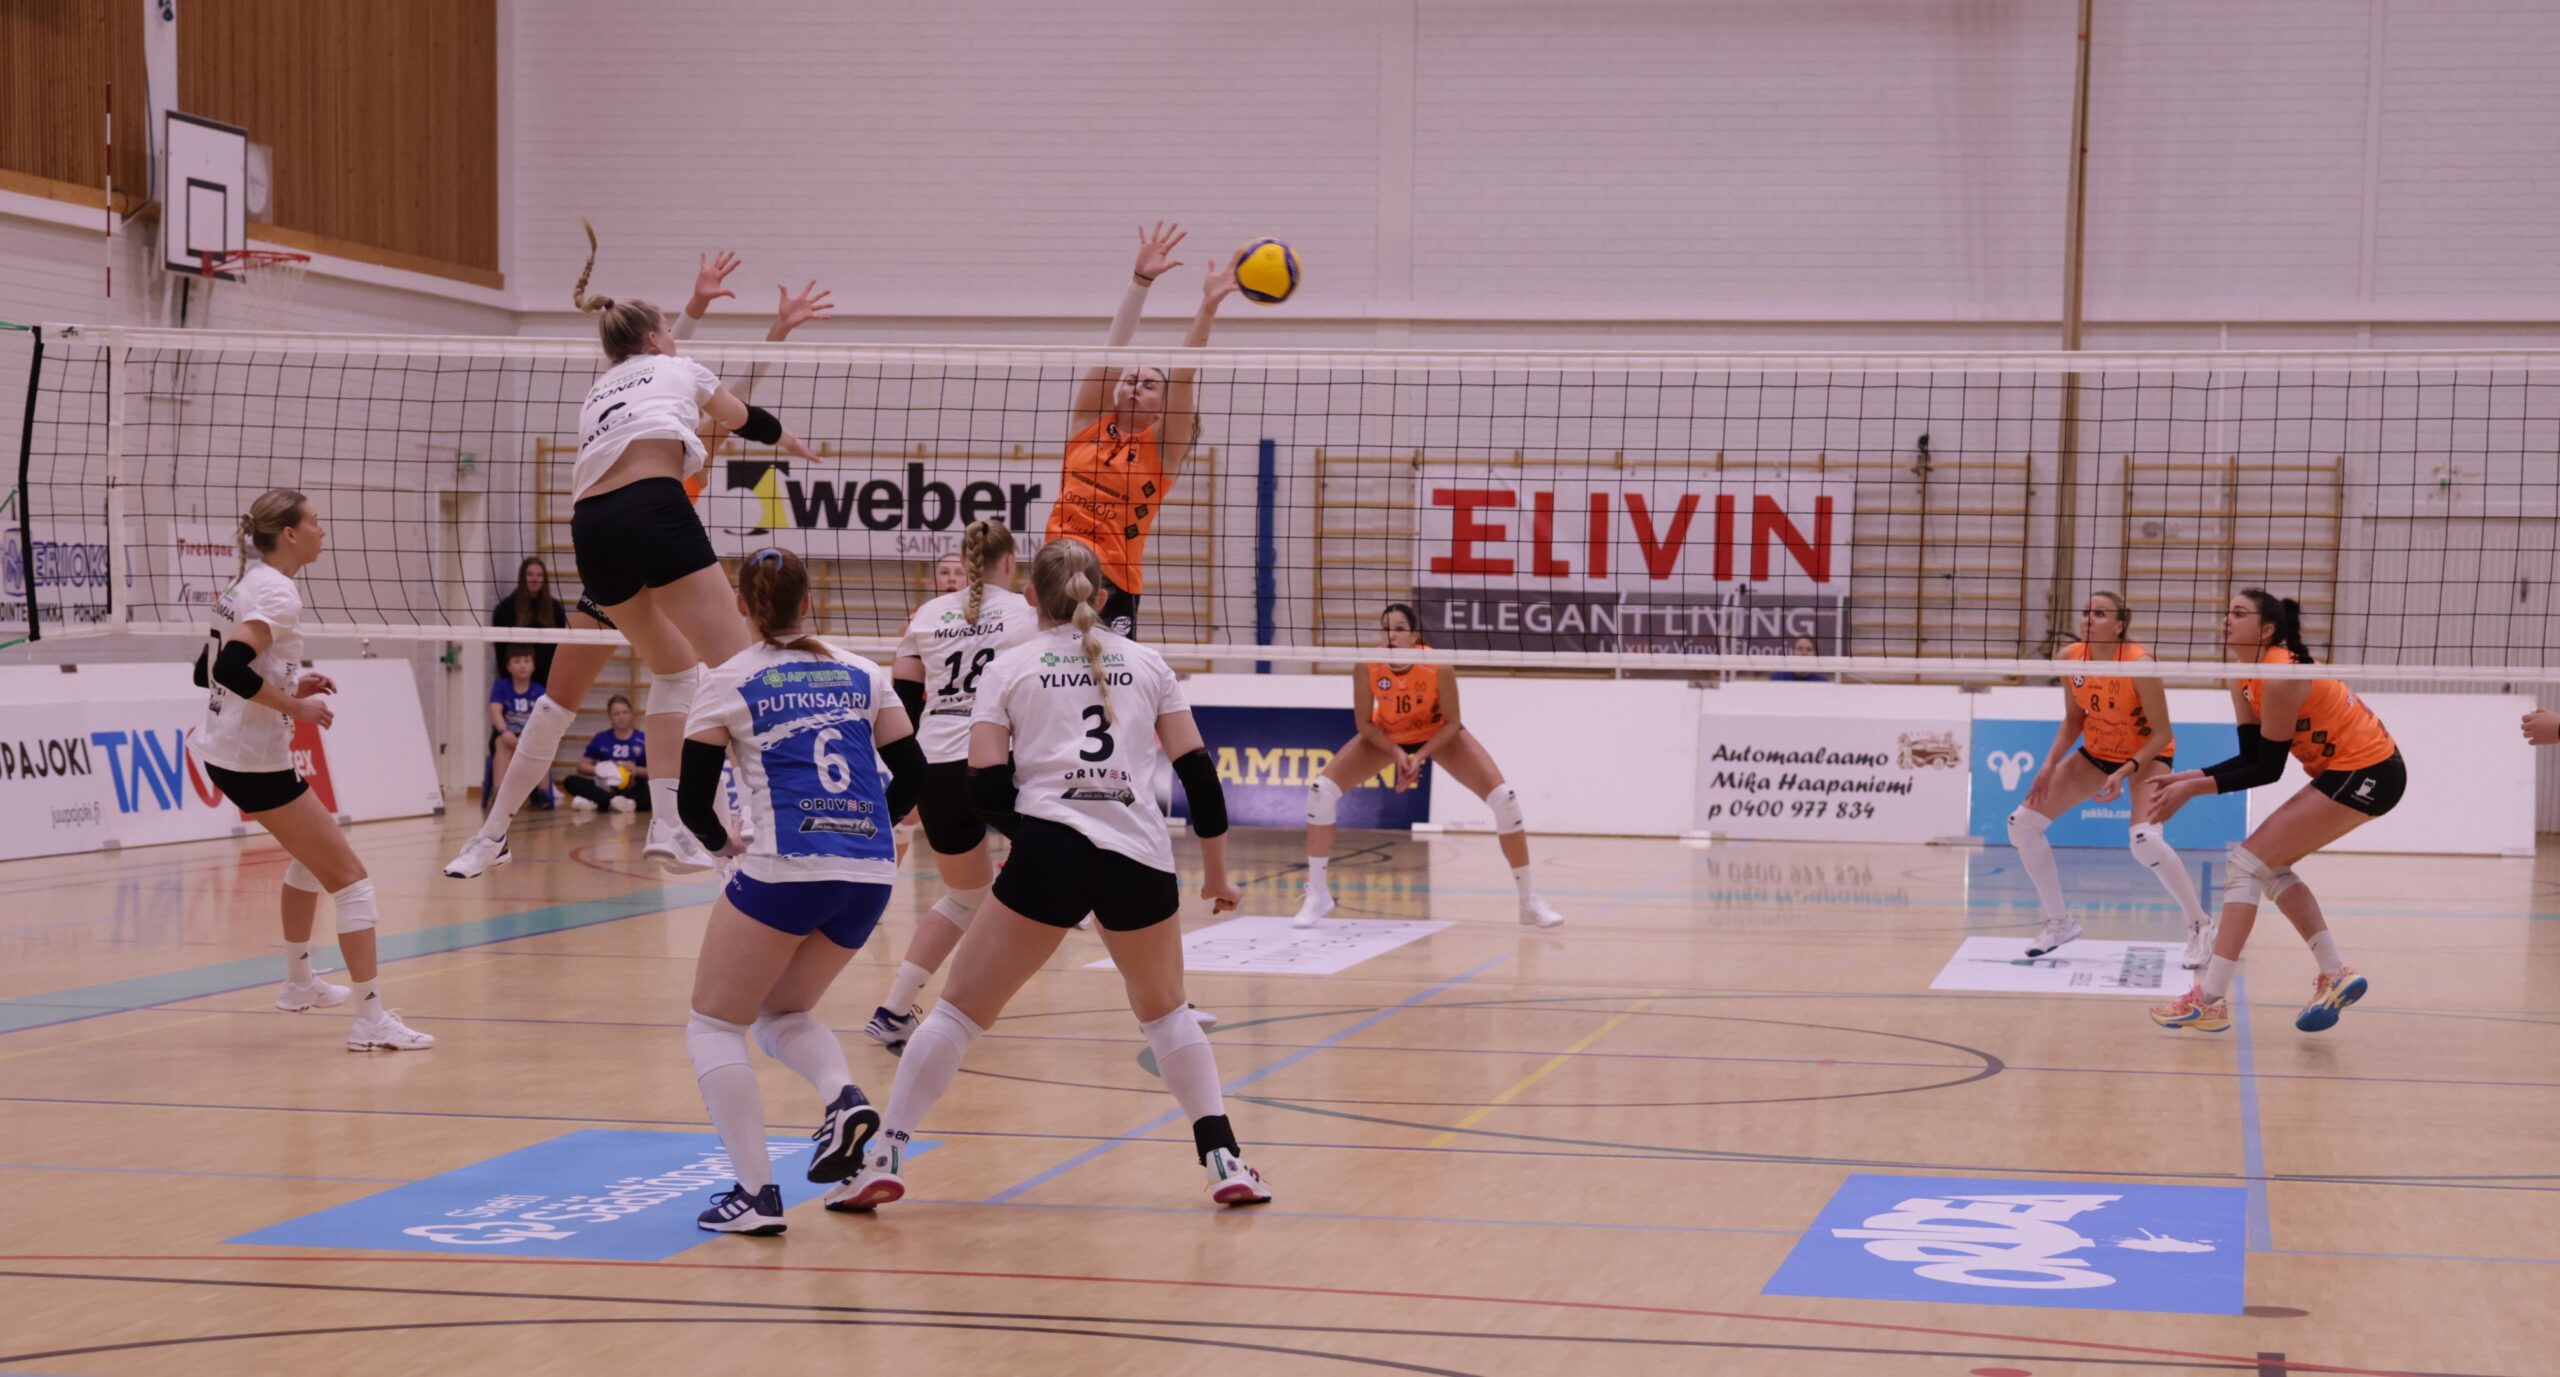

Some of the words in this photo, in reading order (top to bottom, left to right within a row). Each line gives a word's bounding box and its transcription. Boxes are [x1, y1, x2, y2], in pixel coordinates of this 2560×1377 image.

[786, 462, 1041, 531] weber
[1431, 488, 1833, 583] ELIVIN
[934, 622, 1004, 639] MURSULA
[1444, 599, 1649, 635] ELEGANT
[1665, 605, 1815, 637] LIVING
[938, 648, 994, 696] 18
[758, 691, 867, 717] PUTKISAARI
[1396, 694, 1411, 714] 16
[1079, 704, 1115, 762] 3
[0, 737, 92, 780] PAJOKI
[813, 727, 851, 794] 6
[1711, 743, 1889, 767] Automaalaamo
[1710, 771, 1771, 793] Mika
[1777, 772, 1914, 796] Haapaniemi
[1708, 802, 1722, 820] p
[1729, 800, 1784, 818] 0400
[1791, 801, 1828, 819] 977
[1836, 801, 1875, 820] 834
